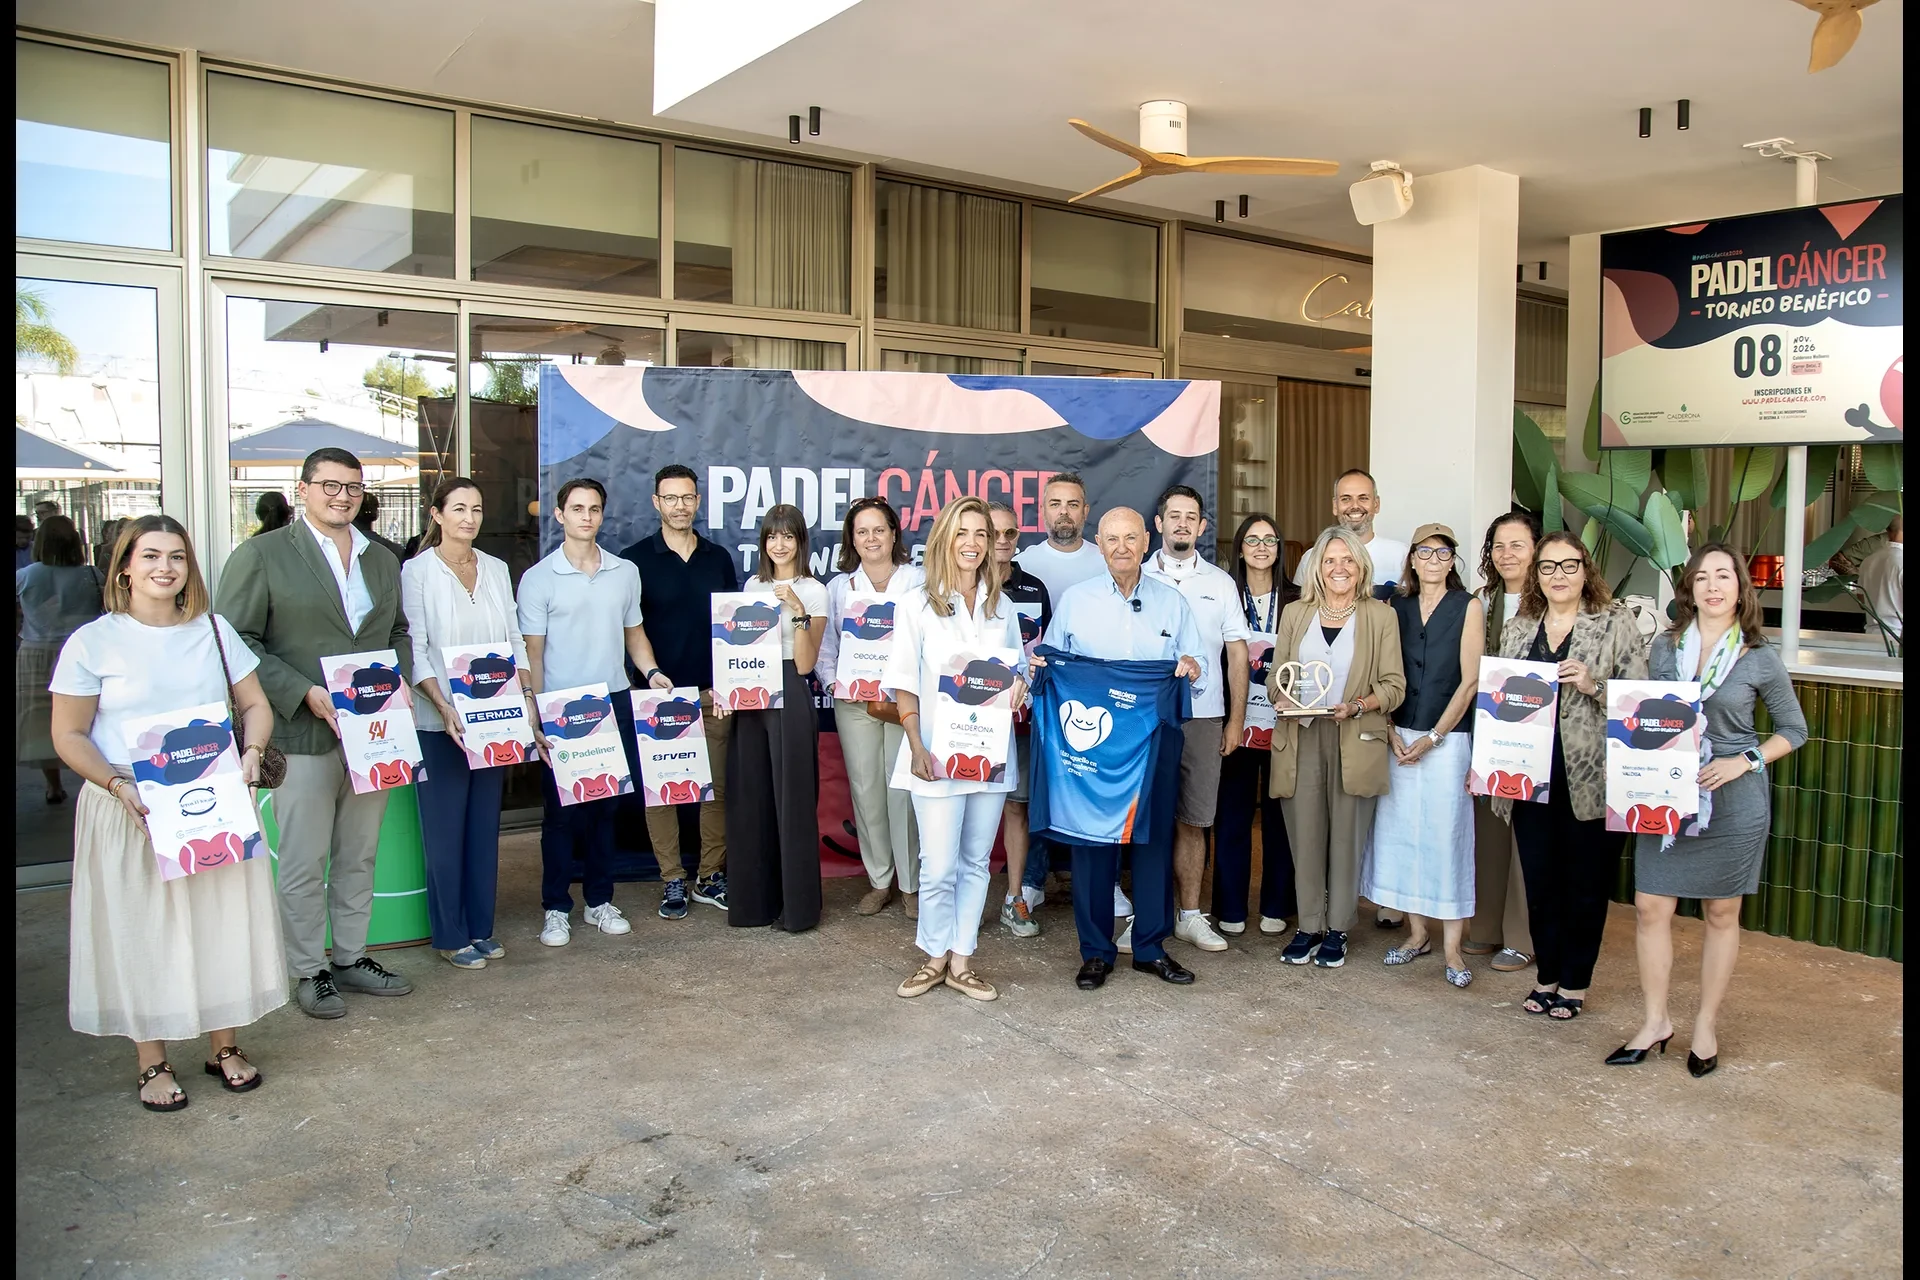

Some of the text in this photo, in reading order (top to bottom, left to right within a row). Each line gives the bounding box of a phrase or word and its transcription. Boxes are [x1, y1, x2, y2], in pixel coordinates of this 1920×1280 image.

[1705, 288, 1871, 320] TORNEO BENÉFICO
[1793, 336, 1812, 345] NOV.
[1793, 344, 1816, 353] 2026
[1734, 334, 1782, 379] 08
[1754, 388, 1802, 397] INSCRIPCIONES
[474, 671, 508, 680] PADELCÁNCER
[967, 676, 1003, 687] PADELCÁNCER
[357, 682, 392, 694] PADELCÁNCER
[1505, 692, 1543, 704] PADELCÁNCER
[467, 708, 522, 722] FERMAX
[950, 722, 994, 734] CALDERONA
[1640, 717, 1684, 728] PADELCÁNCER
[170, 742, 219, 761] PADELCÁNCER
[572, 745, 616, 759] Padeliner
